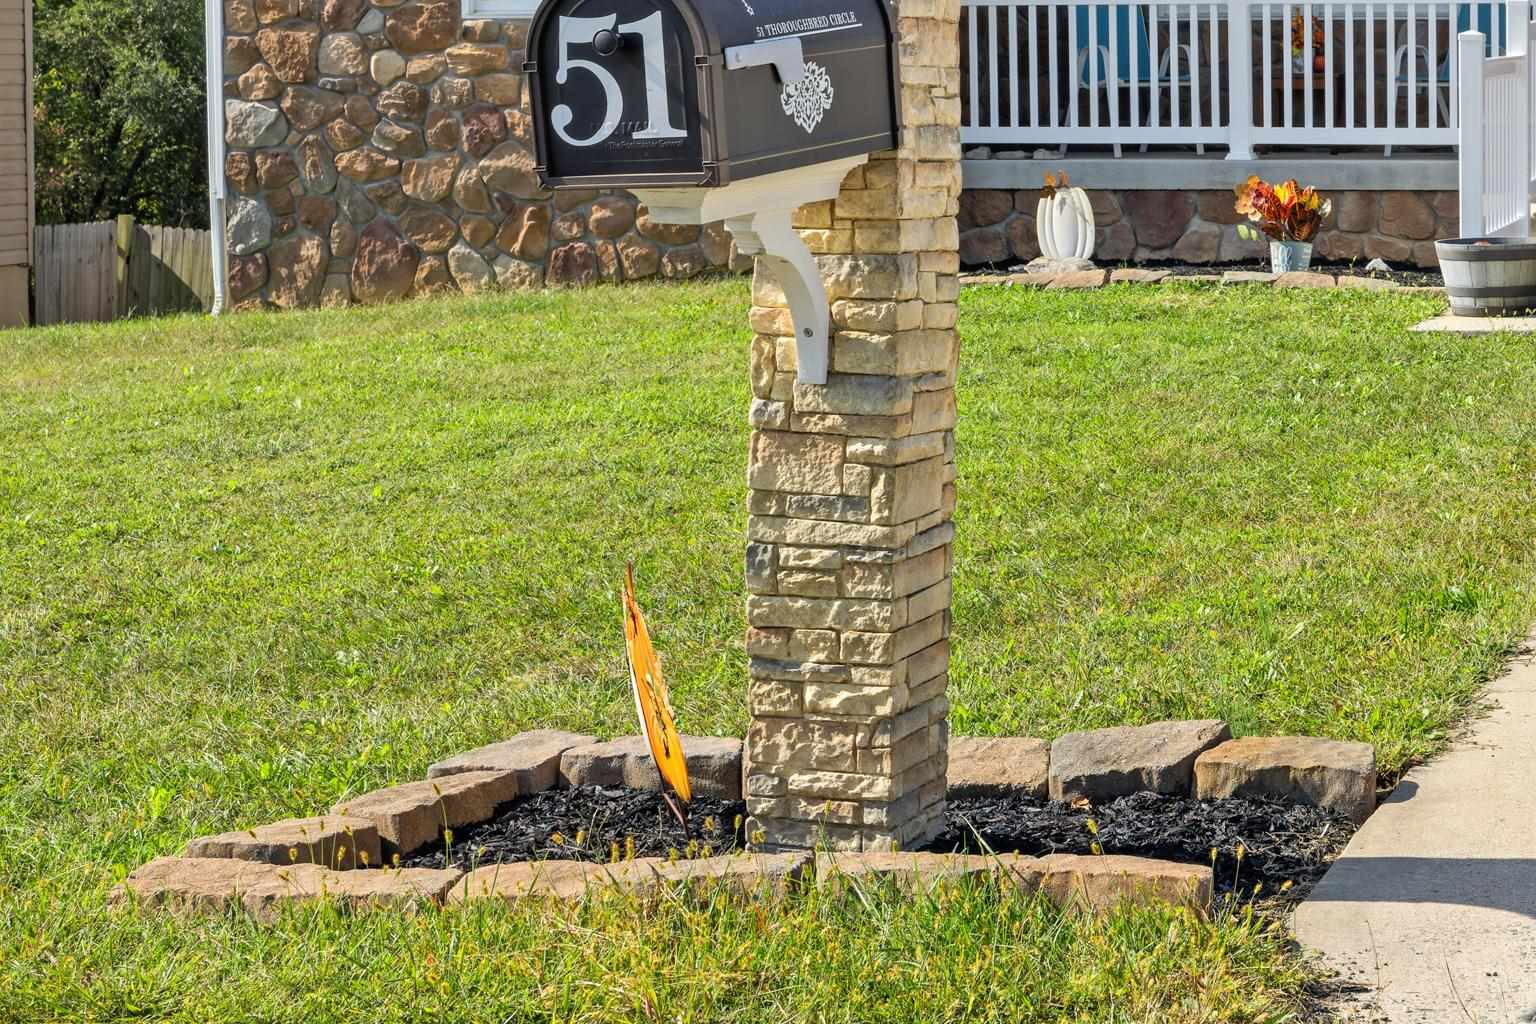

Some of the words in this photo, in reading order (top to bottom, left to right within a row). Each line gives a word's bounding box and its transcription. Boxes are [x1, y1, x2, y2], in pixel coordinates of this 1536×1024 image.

[756, 25, 765, 38] 51
[765, 15, 829, 36] THOROUGHBRED
[830, 11, 857, 25] CIRCLE
[551, 10, 688, 147] 51
